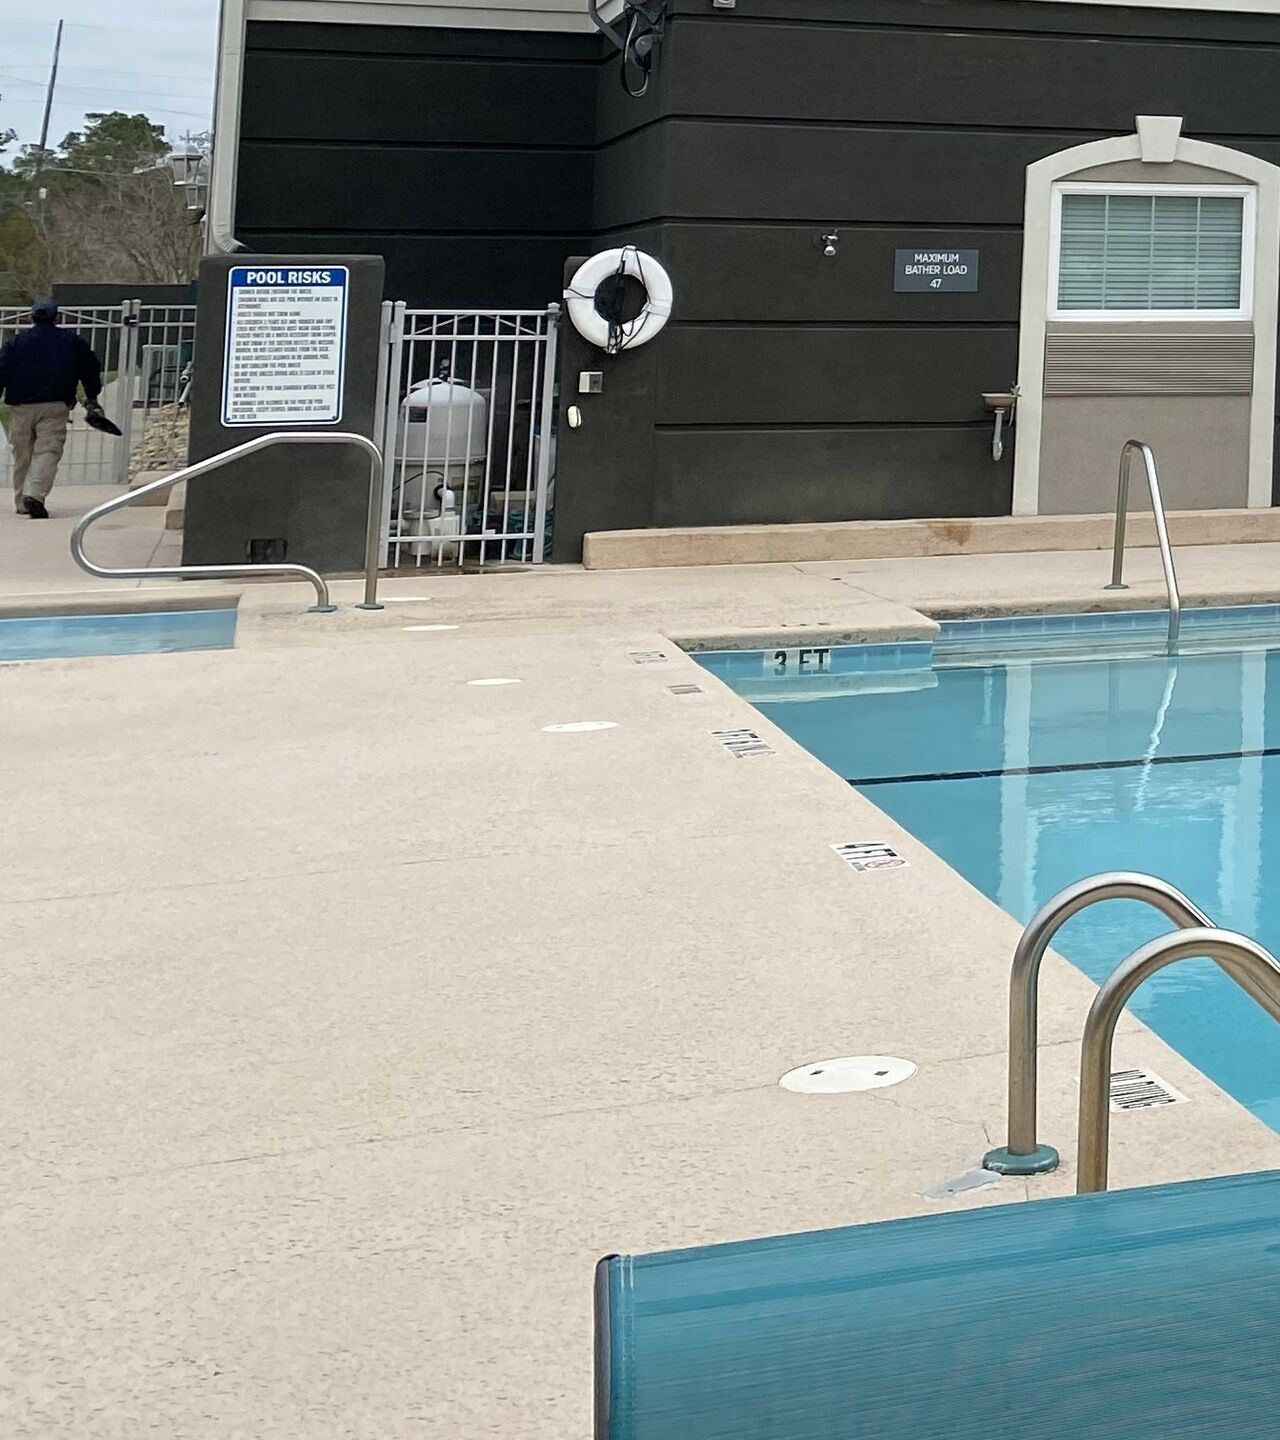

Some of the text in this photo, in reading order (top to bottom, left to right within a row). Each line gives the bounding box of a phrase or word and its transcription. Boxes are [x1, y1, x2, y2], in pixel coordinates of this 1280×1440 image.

[914, 253, 959, 263] MAXIMUM
[905, 264, 968, 275] BATHER LOAD
[246, 271, 332, 284] POOL RISKS
[929, 278, 942, 288] 47
[799, 648, 829, 665] FT
